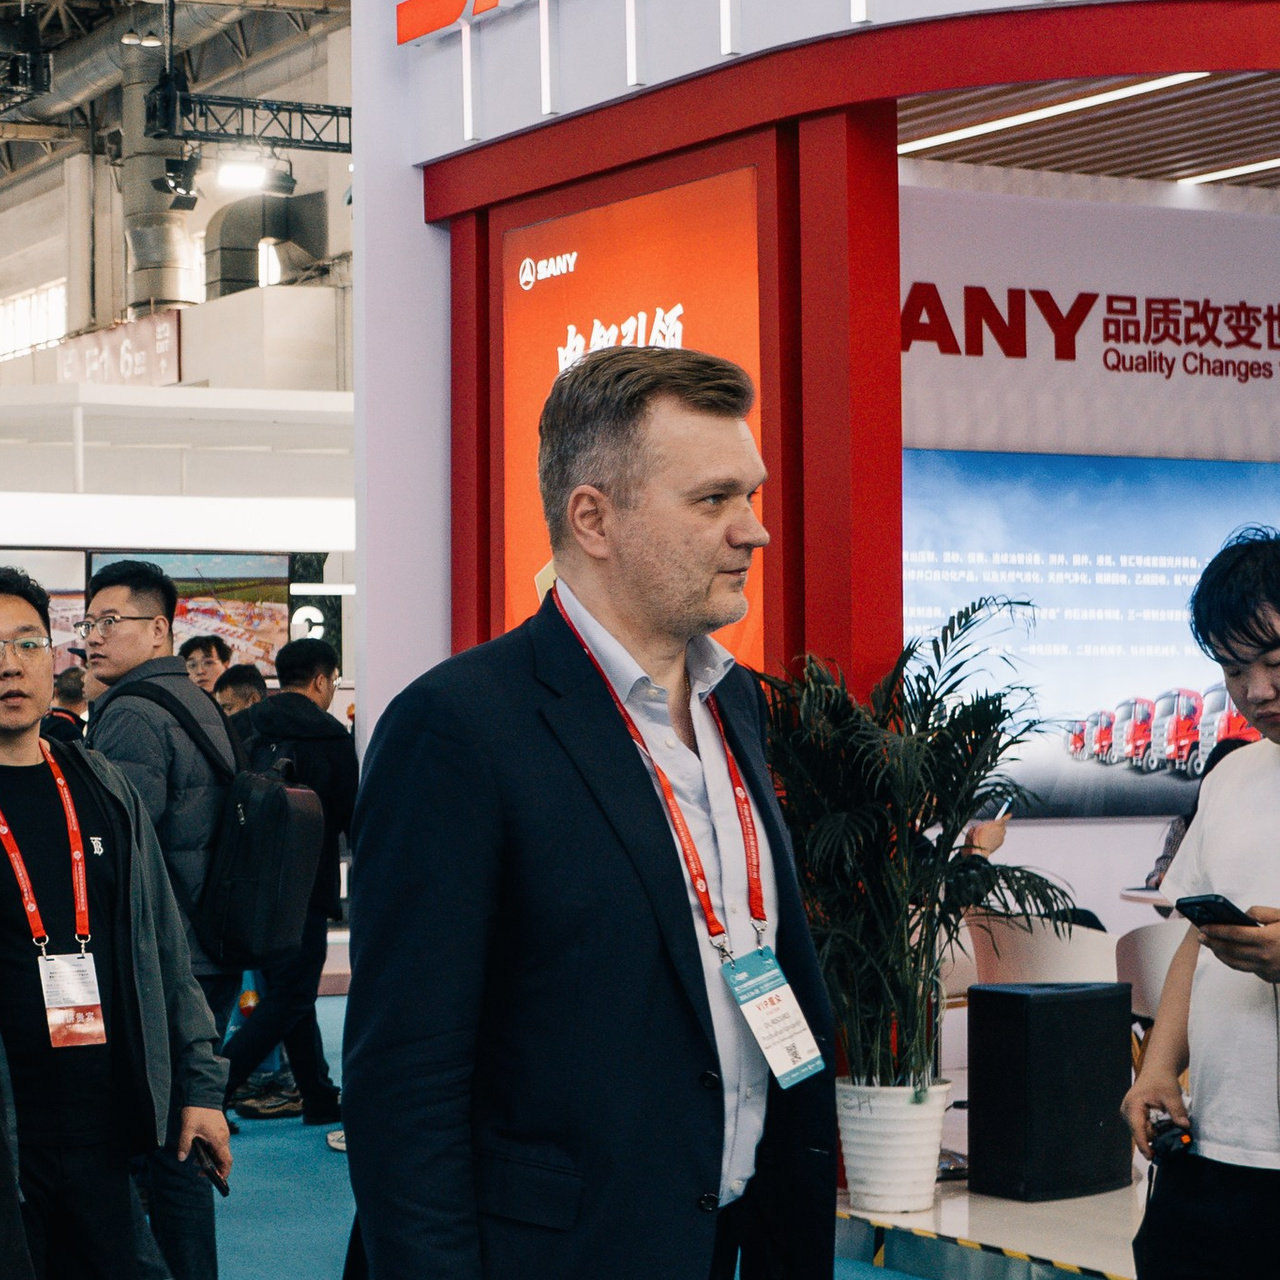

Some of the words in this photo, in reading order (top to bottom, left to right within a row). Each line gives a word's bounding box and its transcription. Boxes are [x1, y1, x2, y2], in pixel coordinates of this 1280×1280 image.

[536, 251, 578, 280] SANY
[900, 281, 1100, 361] ANY
[1102, 347, 1176, 380] Quality
[1182, 350, 1273, 383] Changes
